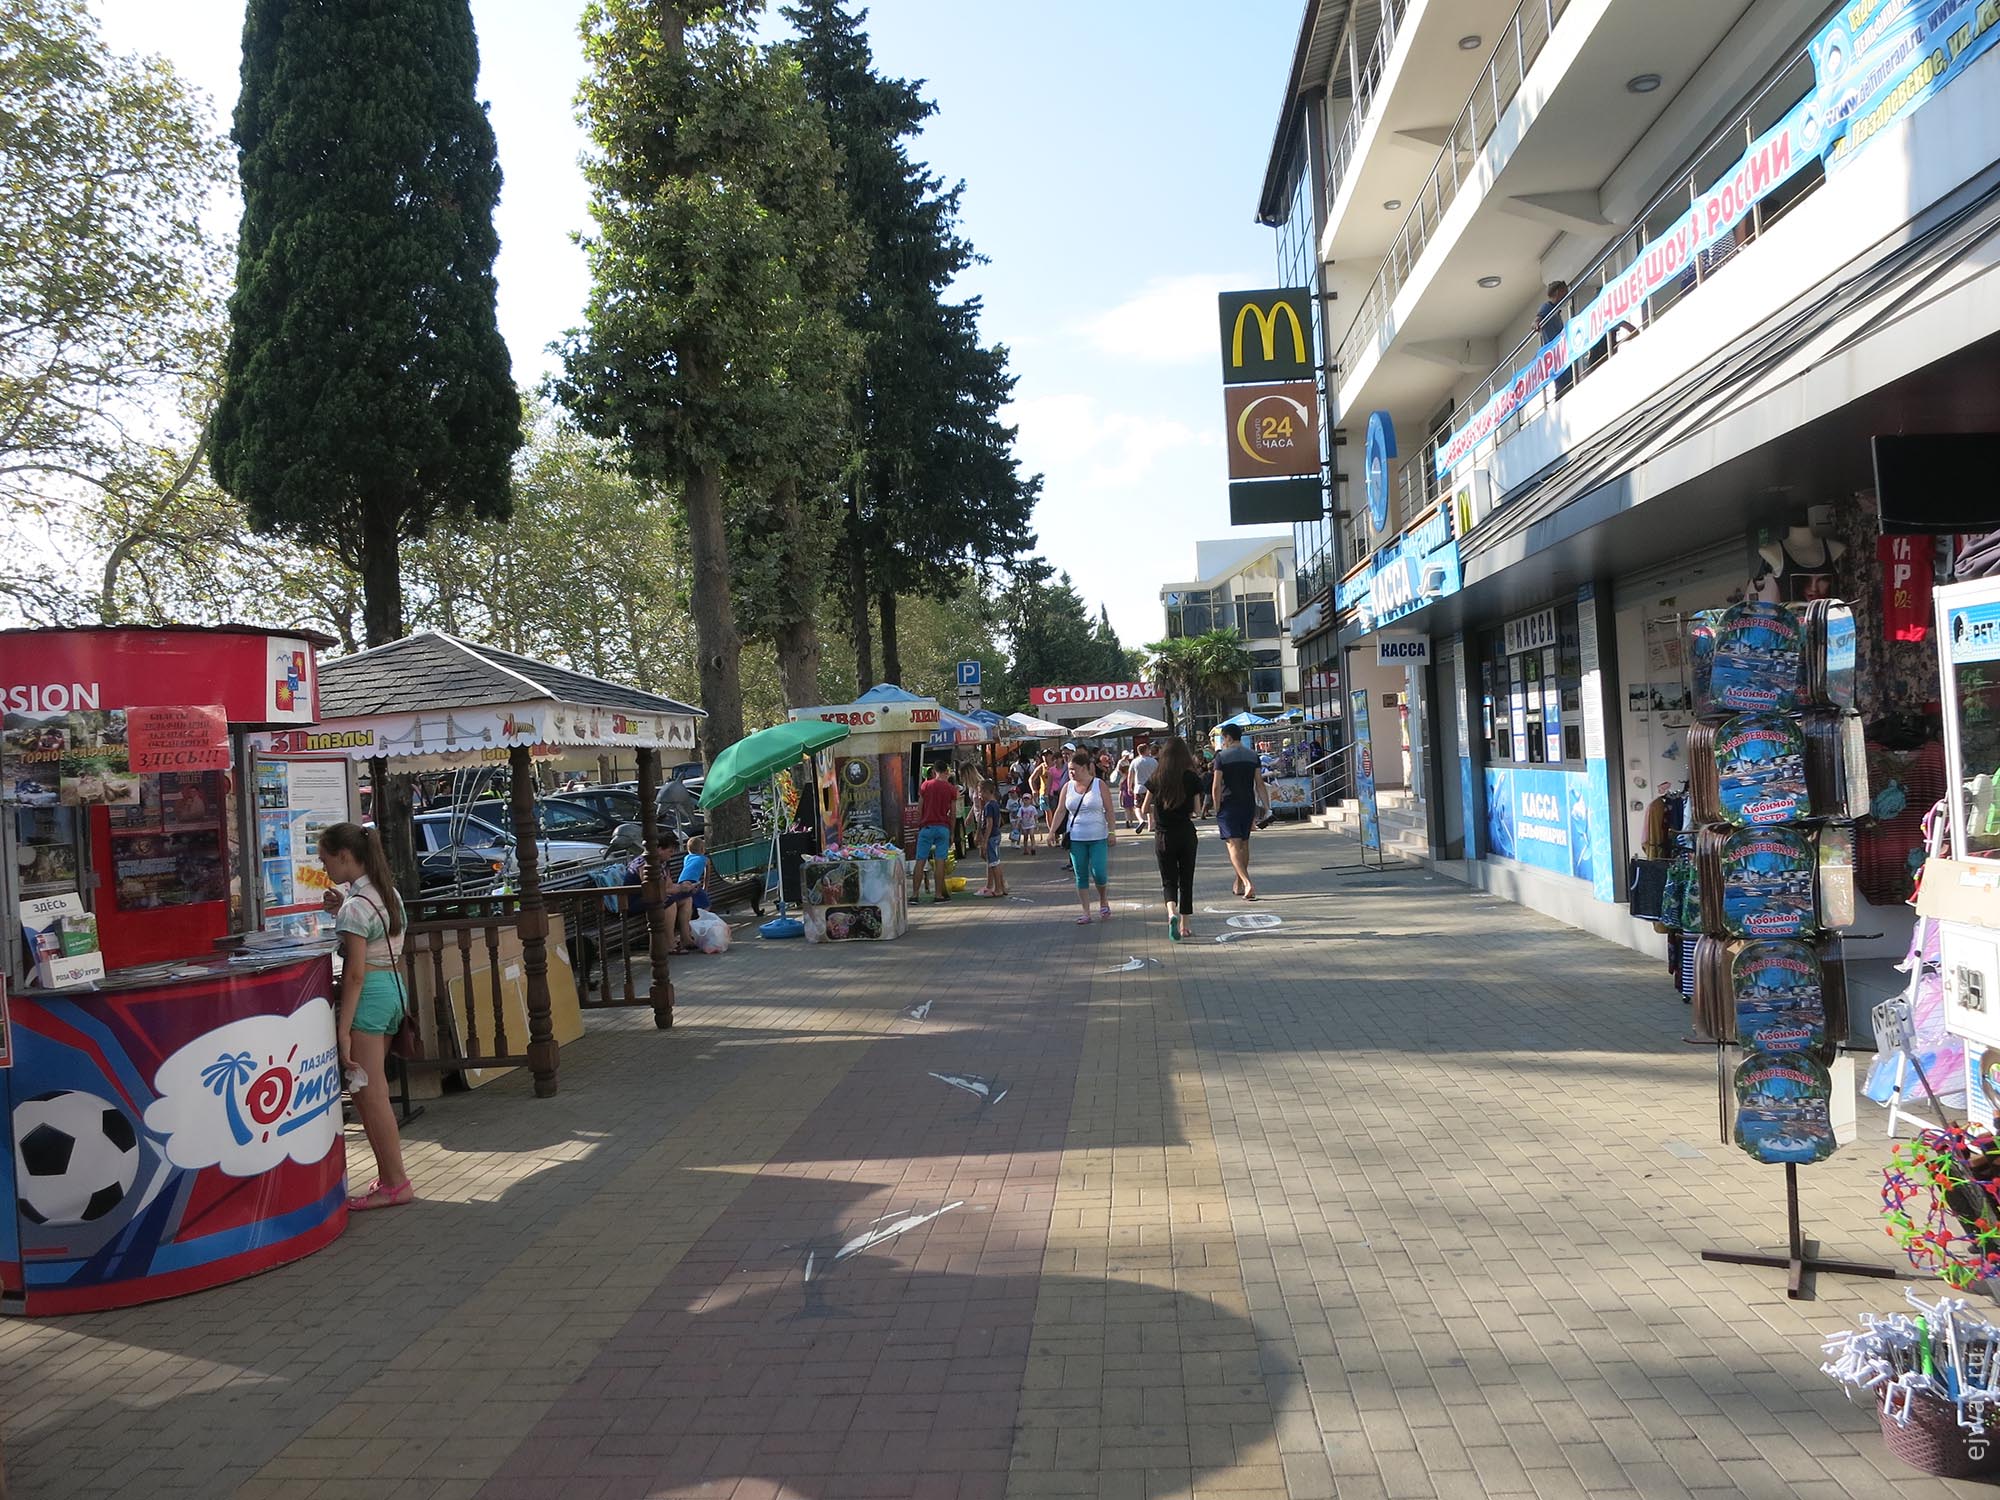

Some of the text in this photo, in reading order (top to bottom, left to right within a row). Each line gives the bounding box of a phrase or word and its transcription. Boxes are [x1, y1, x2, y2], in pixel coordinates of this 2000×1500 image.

[1588, 268, 1645, 341] ЛУЧШЕЕ
[1645, 226, 1687, 288] ШОУ
[1706, 130, 1791, 236] РОССИИ
[1262, 416, 1293, 439] 24
[1262, 438, 1294, 448] ЧАСА
[1370, 555, 1413, 618] КАССА
[1516, 611, 1553, 649] КАССА
[1727, 617, 1794, 639] ЛАЗАРЕВСКОЕ
[1381, 642, 1426, 658] КАССА
[963, 665, 975, 682] P
[1043, 683, 1157, 703] СТОЛОВАЯ
[1726, 687, 1777, 700] Любимой
[1726, 698, 1771, 711] Свекрови
[270, 729, 374, 752] 3D ПАЗЛЫ
[1722, 730, 1790, 755] ЛАЗАРЕВСКОЕ
[20, 751, 65, 764] ГОРНОЕ
[139, 750, 219, 768] ЗДЕСЬ!!!
[1521, 791, 1560, 821] КАССА
[1743, 798, 1796, 815] Любимой
[1752, 811, 1788, 823] Сестре
[1728, 842, 1799, 861] ЛАЗАРЕВСКОЕ
[32, 899, 67, 913] ЗДЕСЬ
[1744, 911, 1799, 925] Любимой
[1751, 925, 1793, 935] Соседке
[56, 967, 101, 982] РОЗА ХУТОР
[1740, 958, 1809, 977] ЛАЗАРЕВСКОЕ
[1756, 1028, 1809, 1041] Любимой
[1766, 1041, 1801, 1050] Свахе
[1743, 1067, 1815, 1086] ЛАЗАРЕВСКОЕ
